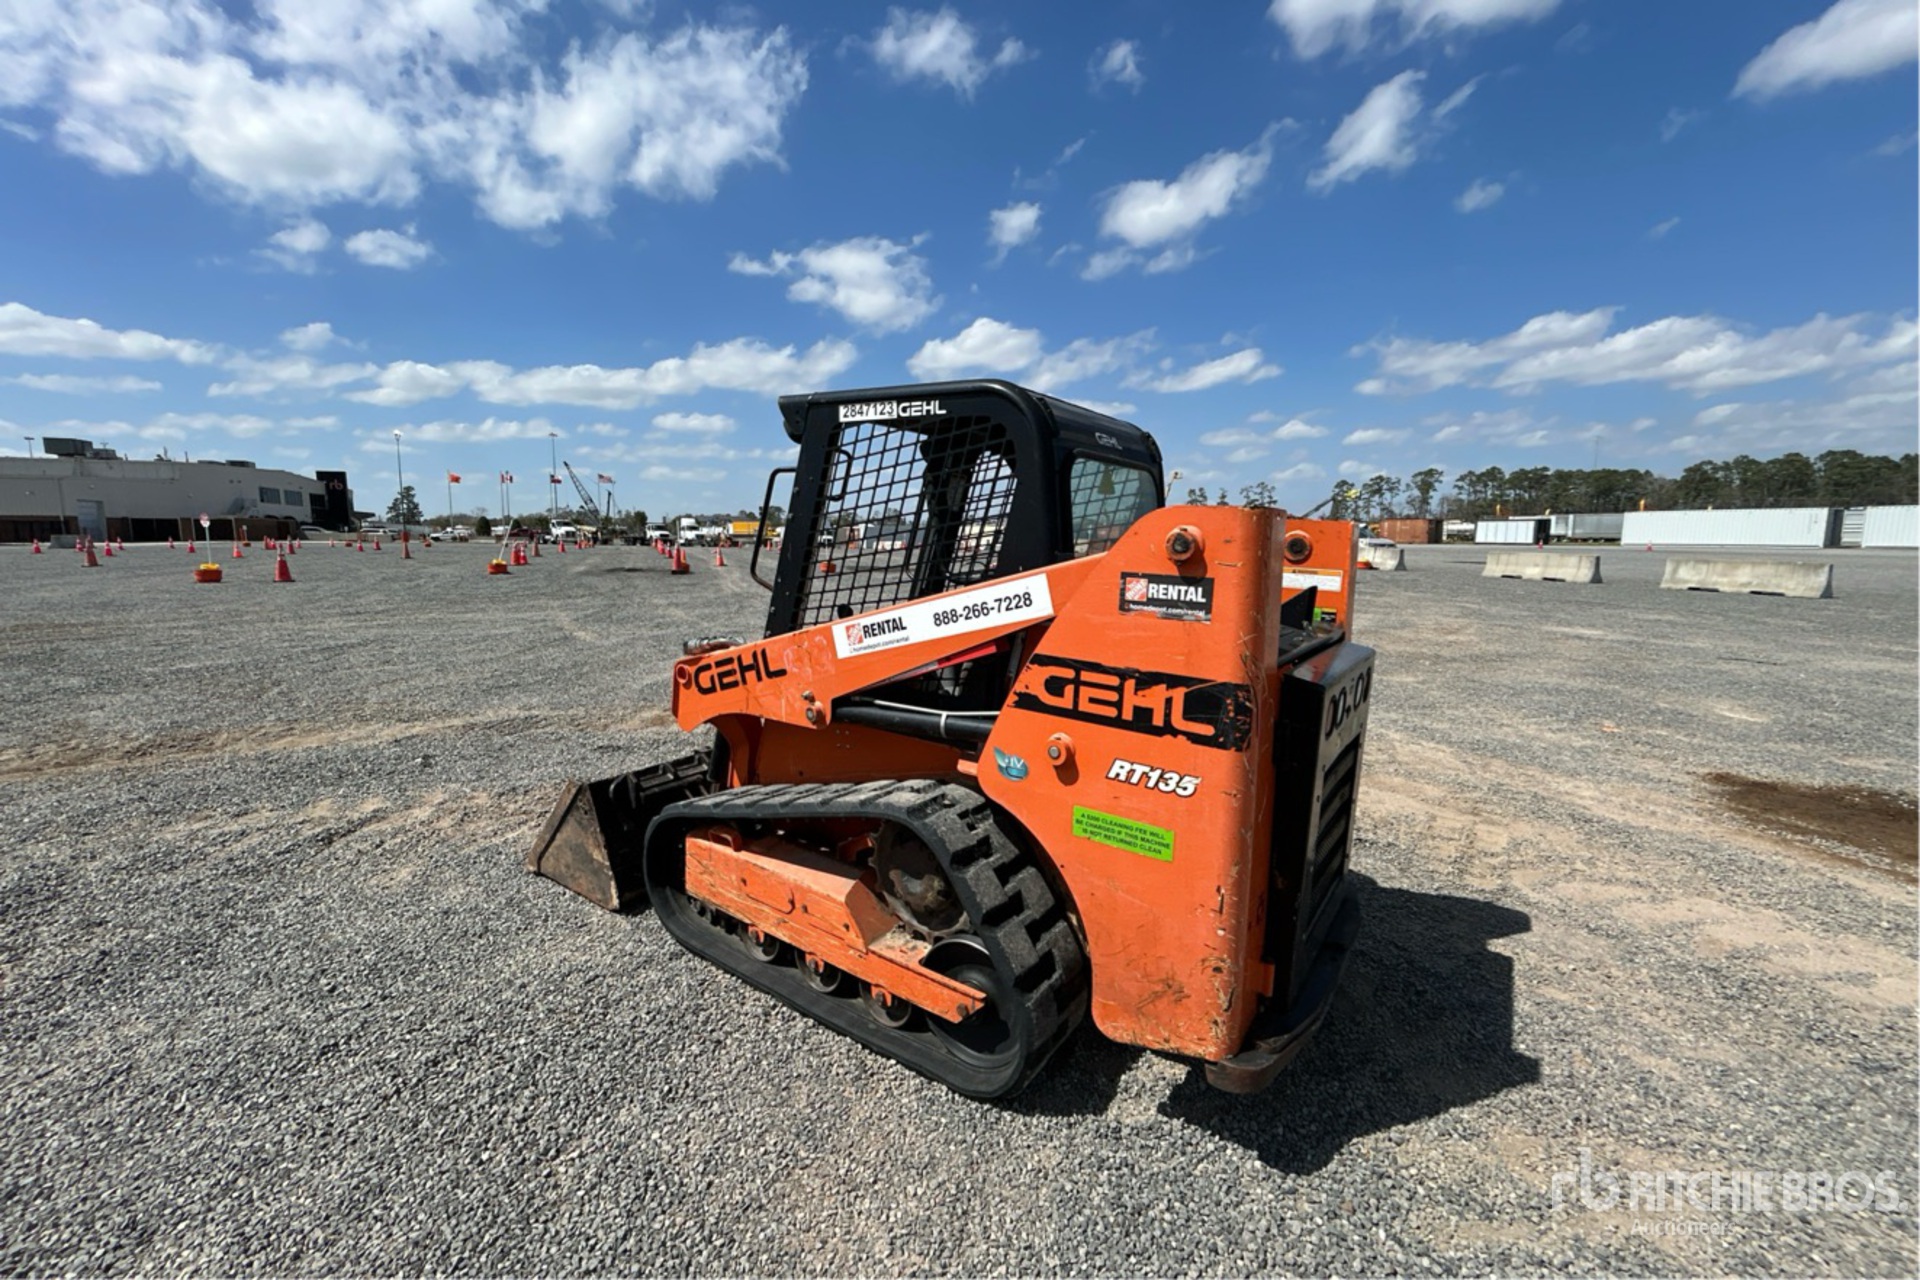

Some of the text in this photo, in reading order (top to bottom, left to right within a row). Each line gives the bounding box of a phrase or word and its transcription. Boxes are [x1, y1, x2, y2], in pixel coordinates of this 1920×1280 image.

[843, 402, 895, 418] 2847123
[898, 400, 947, 417] GEHL
[1148, 583, 1206, 603] RENTAL
[933, 592, 1033, 627] 888-266-7228
[862, 617, 907, 639] RENTAL
[693, 648, 788, 695] GEHL
[1036, 664, 1216, 737] GEHL
[1106, 758, 1203, 797] RT135
[1085, 821, 1116, 833] CHARGED
[1124, 832, 1139, 840] THIS
[1140, 836, 1170, 849] MACHINE
[1101, 818, 1134, 831] CLEANING
[1135, 827, 1148, 835] FEE
[1149, 831, 1165, 840] WILL
[1103, 833, 1138, 848] RETURNED
